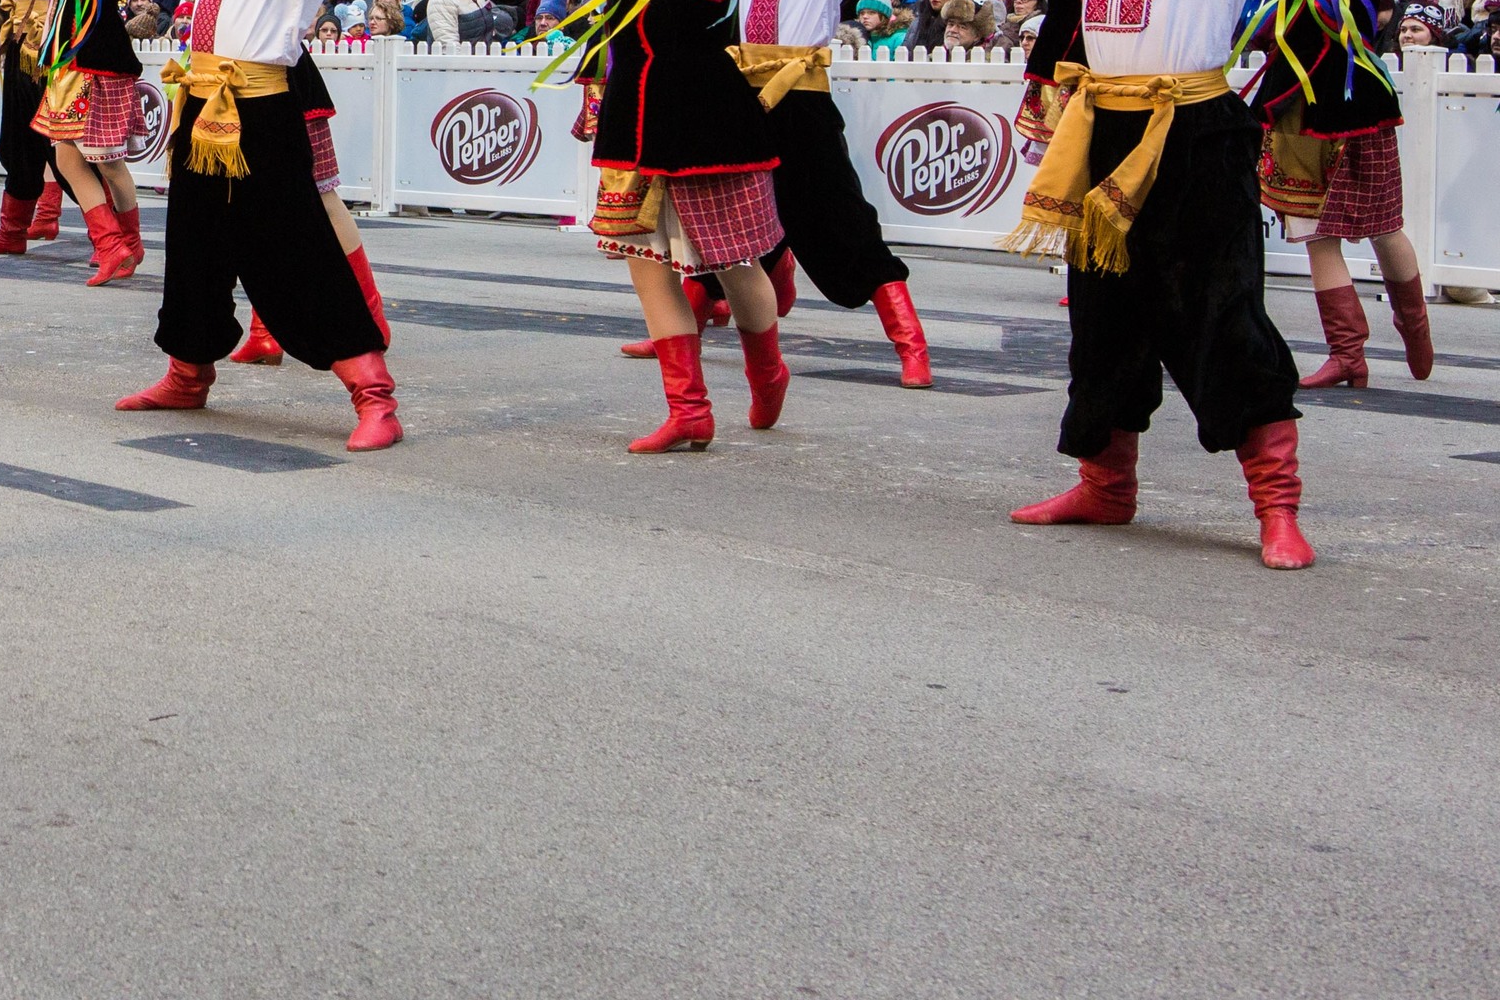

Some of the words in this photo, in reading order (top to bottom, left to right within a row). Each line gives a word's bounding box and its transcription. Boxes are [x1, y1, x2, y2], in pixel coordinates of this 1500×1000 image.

[443, 111, 520, 171] Pepper
[471, 103, 501, 140] Dr
[927, 119, 965, 162] Dr
[891, 128, 990, 200] Pepper
[953, 170, 980, 189] Est.1885
